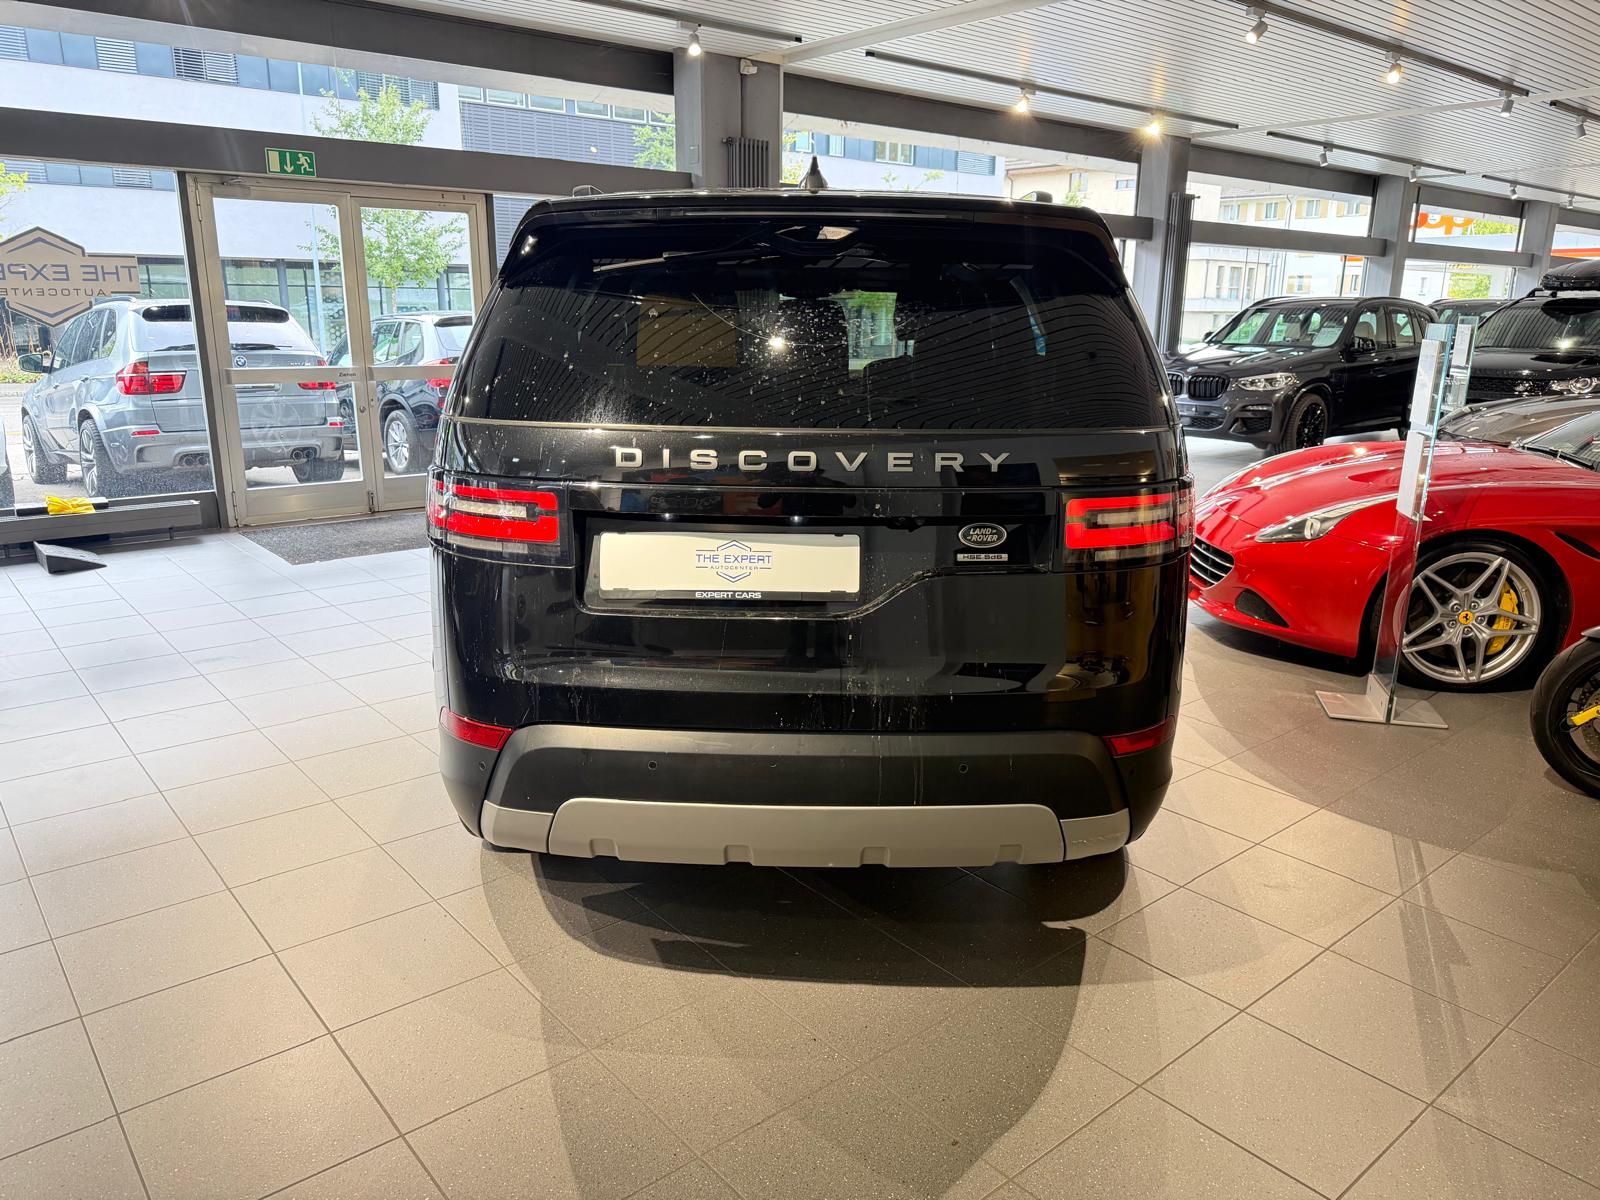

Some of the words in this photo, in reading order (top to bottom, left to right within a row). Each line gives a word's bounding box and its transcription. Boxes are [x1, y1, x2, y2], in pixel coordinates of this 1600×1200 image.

[615, 448, 1010, 473] DISCOVERY
[696, 554, 720, 563] THE
[724, 554, 772, 564] EXPERT
[695, 591, 734, 599] EXPERT
[735, 591, 762, 599] CARS
